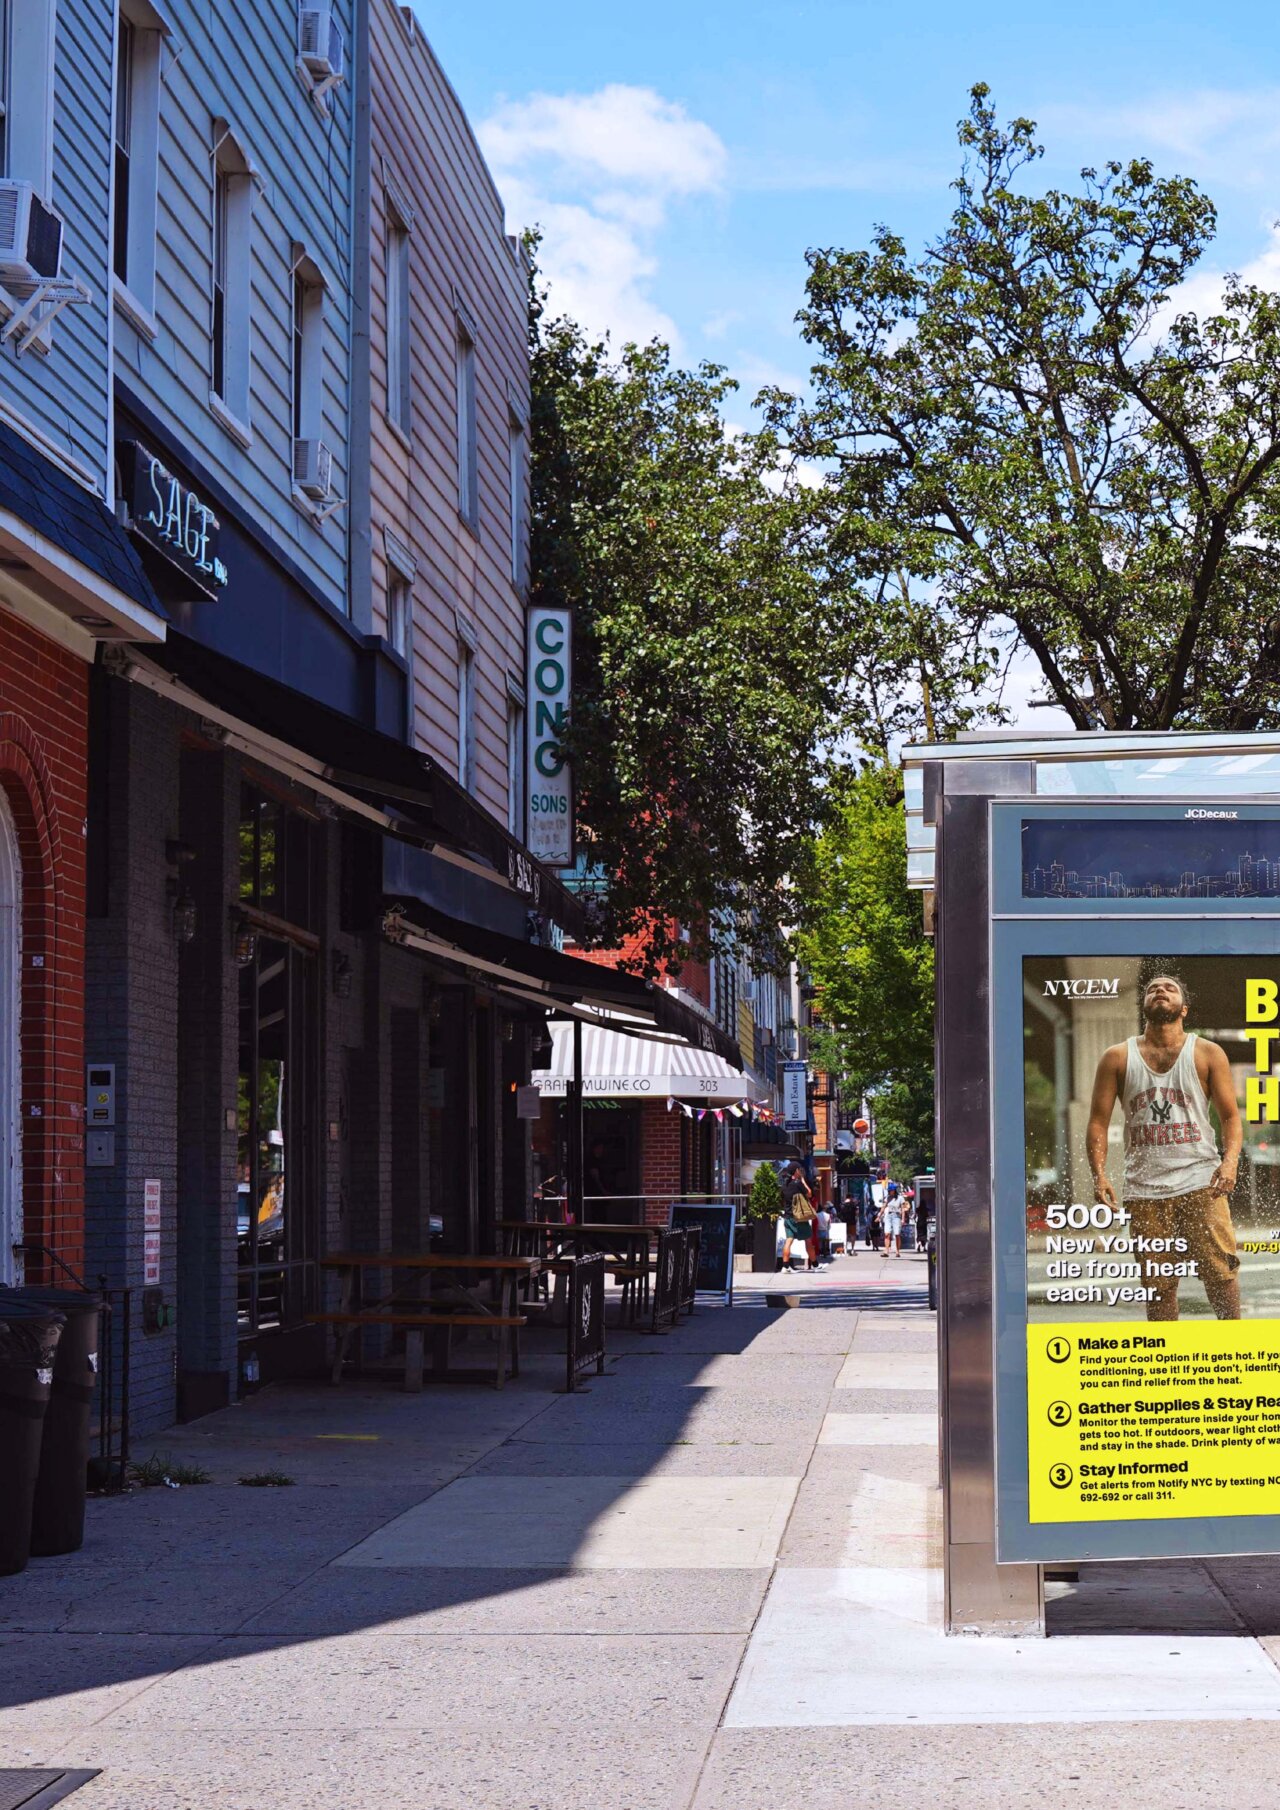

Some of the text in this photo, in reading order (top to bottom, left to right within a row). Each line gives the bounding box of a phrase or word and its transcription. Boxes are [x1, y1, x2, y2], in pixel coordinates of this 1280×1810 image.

[531, 794, 567, 814] SONS
[1184, 808, 1239, 819] JCDecaux
[1042, 978, 1120, 996] NYCEM
[699, 1080, 718, 1091] 303
[791, 1073, 799, 1099] Estate
[791, 1101, 799, 1119] Real
[1046, 1203, 1132, 1230] 500+
[1046, 1234, 1188, 1253] New Yorkers
[1046, 1258, 1199, 1278] die from heat
[1046, 1285, 1162, 1307] each year.
[1054, 1336, 1166, 1356] 1 Make a Plan
[1080, 1355, 1102, 1364] Find
[1104, 1356, 1127, 1366] your
[1129, 1354, 1153, 1363] Cool
[1155, 1353, 1190, 1364] Option
[1192, 1353, 1199, 1361] if
[1202, 1352, 1209, 1361] it
[1211, 1353, 1233, 1363] gets
[1235, 1352, 1255, 1360] hot.
[1258, 1351, 1265, 1360] If
[1080, 1366, 1147, 1377] conditioning,
[1149, 1367, 1168, 1375] use
[1170, 1365, 1180, 1374] it!
[1183, 1365, 1190, 1373] If
[1192, 1366, 1211, 1375] you
[1213, 1364, 1242, 1373] don't,
[1080, 1376, 1242, 1390] you can find relief from the heat.
[1055, 1406, 1064, 1419] 2
[1078, 1402, 1132, 1415] Gather
[1134, 1399, 1200, 1414] Supplies
[1203, 1398, 1215, 1410] &
[1217, 1397, 1254, 1411] Stay
[1079, 1418, 1118, 1427] Monitor
[1120, 1417, 1137, 1426] the
[1139, 1416, 1201, 1426] temperature
[1203, 1414, 1234, 1423] inside
[1236, 1414, 1259, 1424] your
[1079, 1431, 1101, 1441] gets
[1104, 1430, 1121, 1438] too
[1123, 1429, 1143, 1438] hot.
[1145, 1428, 1152, 1437] If
[1154, 1427, 1204, 1437] outdoors,
[1206, 1427, 1230, 1435] wear
[1233, 1425, 1255, 1436] light
[1080, 1442, 1099, 1451] and
[1101, 1442, 1122, 1452] stay
[1125, 1441, 1134, 1449] in
[1137, 1440, 1153, 1449] the
[1155, 1439, 1189, 1449] shade.
[1191, 1438, 1219, 1447] Drink
[1221, 1437, 1253, 1448] plenty
[1255, 1436, 1266, 1445] of
[1056, 1460, 1188, 1481] 3 Stay Informed
[1080, 1481, 1098, 1490] Get
[1100, 1481, 1129, 1490] alerts
[1132, 1480, 1155, 1489] from
[1158, 1479, 1189, 1489] Notify
[1191, 1478, 1213, 1487] NYC
[1215, 1478, 1228, 1488] by
[1230, 1477, 1265, 1487] texting
[1080, 1492, 1120, 1502] 692-692
[1135, 1491, 1153, 1500] call
[1156, 1491, 1175, 1500] 311.
